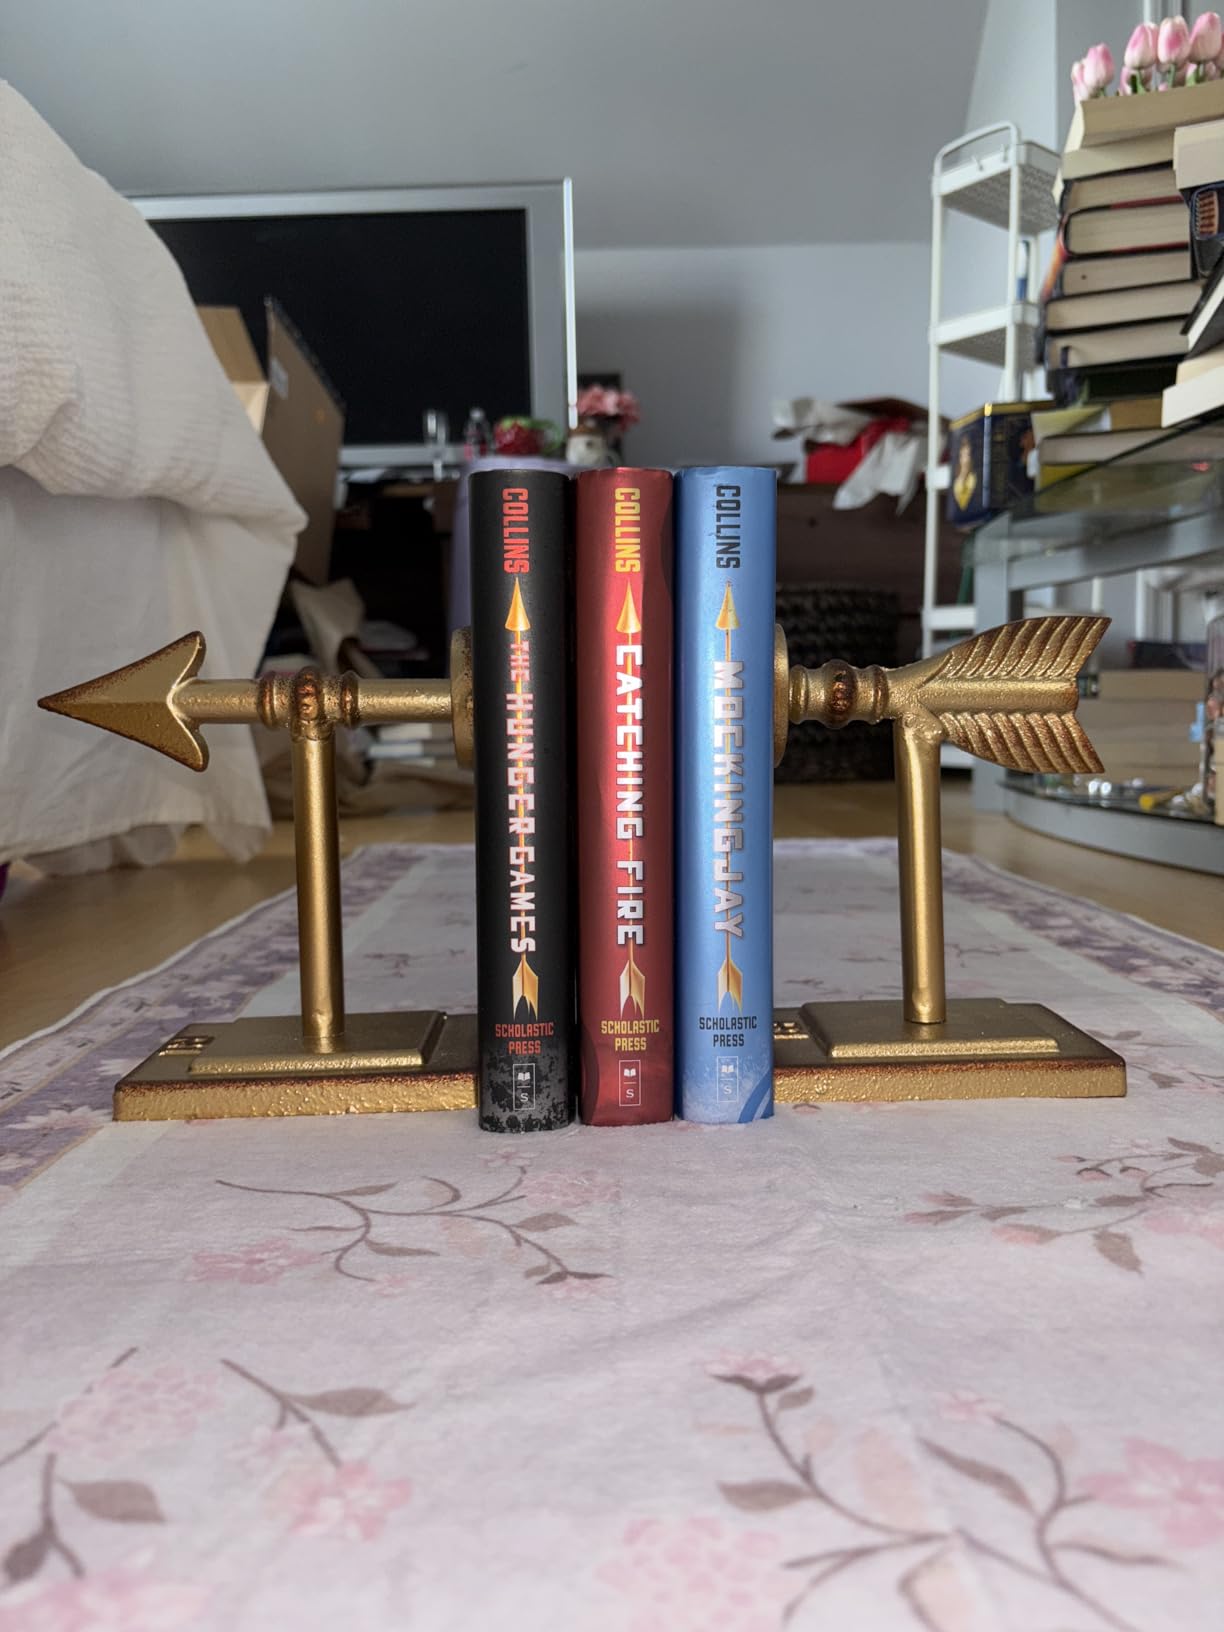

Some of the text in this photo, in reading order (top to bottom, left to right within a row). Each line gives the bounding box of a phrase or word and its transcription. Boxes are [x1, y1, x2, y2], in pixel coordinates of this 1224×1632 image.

[502, 487, 529, 574] COLLINS
[615, 487, 641, 573] COLLINS
[715, 484, 741, 570] COLLINS
[505, 640, 537, 953] THE HUNGER GAMES
[615, 644, 644, 946] CATCHING FIRE
[712, 660, 745, 938] MOCKINGJAY
[495, 1022, 555, 1038] SCHOLASTIC
[600, 1018, 660, 1034] SCHOLASTIC
[698, 1015, 758, 1031] SCHOLASTIC
[508, 1040, 541, 1055] PRESS
[614, 1036, 647, 1052] PRESS
[712, 1033, 745, 1048] PRESS
[519, 1092, 529, 1103] S
[625, 1088, 635, 1099] S
[723, 1084, 732, 1095] S
